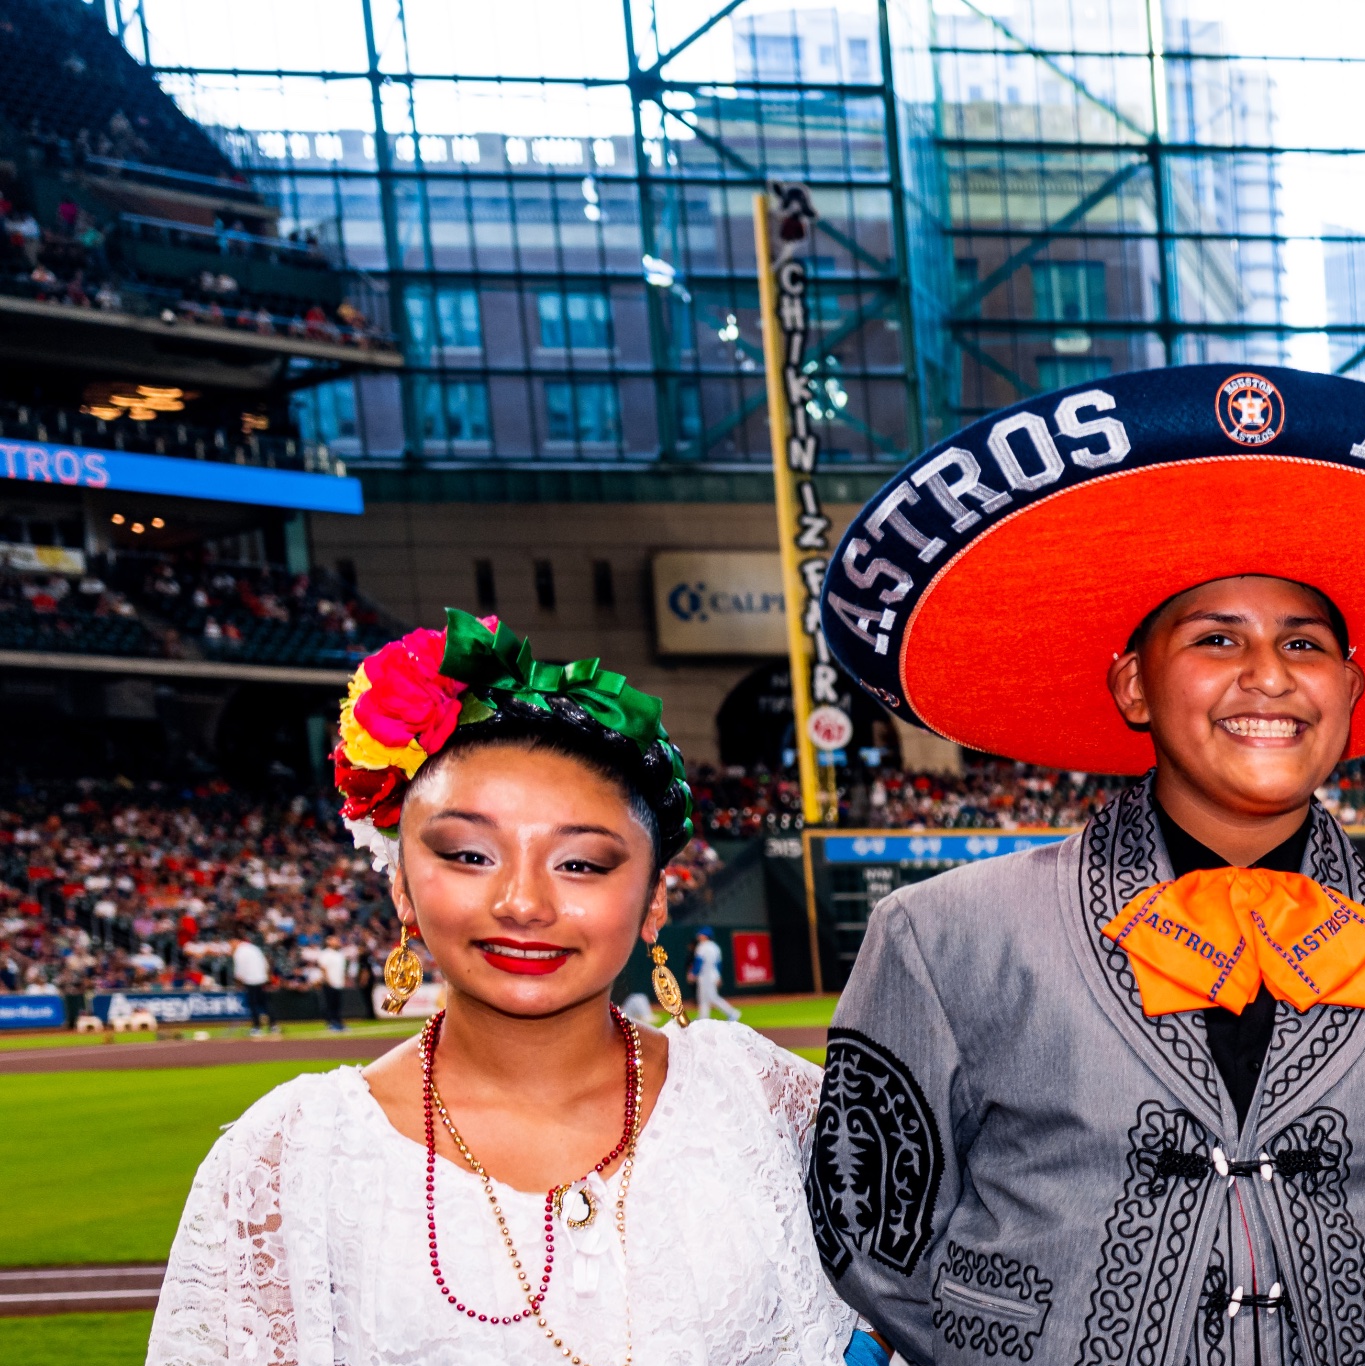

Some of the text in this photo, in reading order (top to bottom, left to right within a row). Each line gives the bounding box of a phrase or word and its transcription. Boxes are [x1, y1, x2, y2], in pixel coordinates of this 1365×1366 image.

[1223, 377, 1274, 395] HOUSTON
[1230, 427, 1276, 443] ASTROS
[829, 389, 1131, 655] ASTROS
[1144, 912, 1229, 969] ASTROS
[1290, 907, 1351, 962] ASTROS
